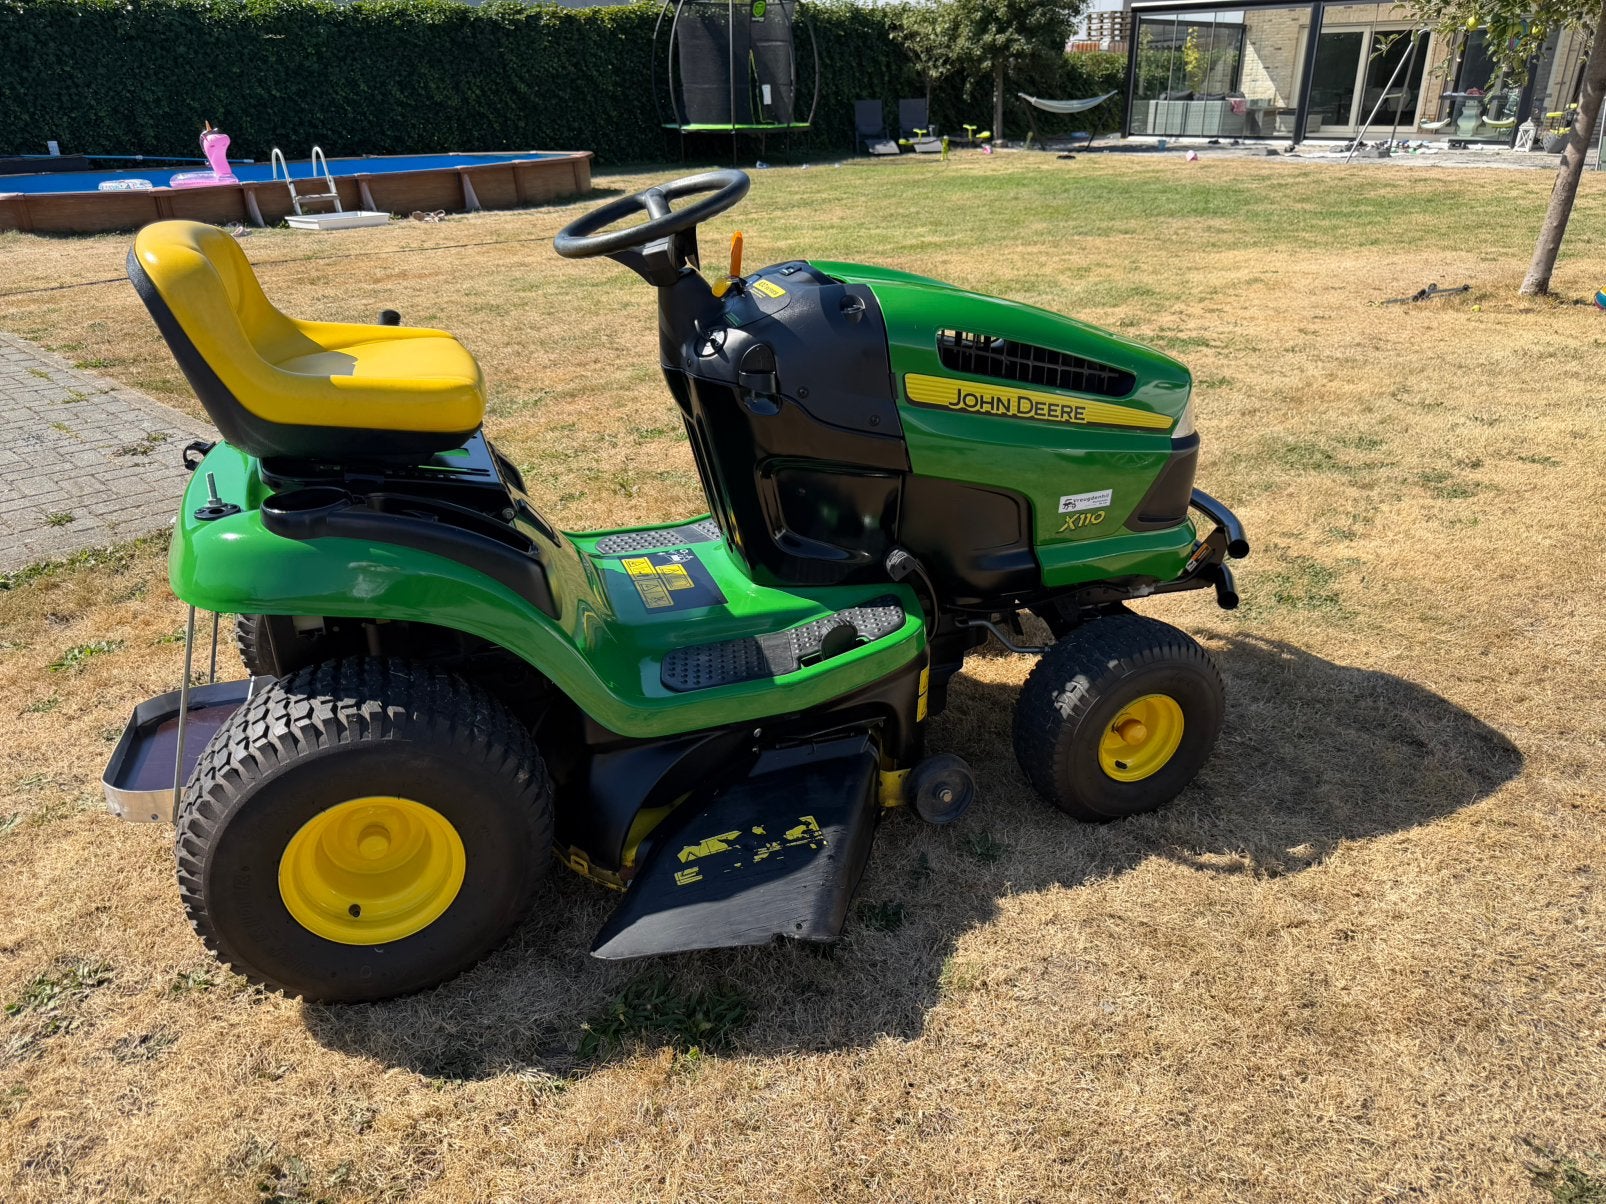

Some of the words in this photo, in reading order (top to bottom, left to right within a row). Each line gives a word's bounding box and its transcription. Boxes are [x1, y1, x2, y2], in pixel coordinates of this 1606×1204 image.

[948, 388, 1011, 413] JOHN
[1017, 395, 1087, 421] DEERE
[1057, 511, 1106, 533] X110
